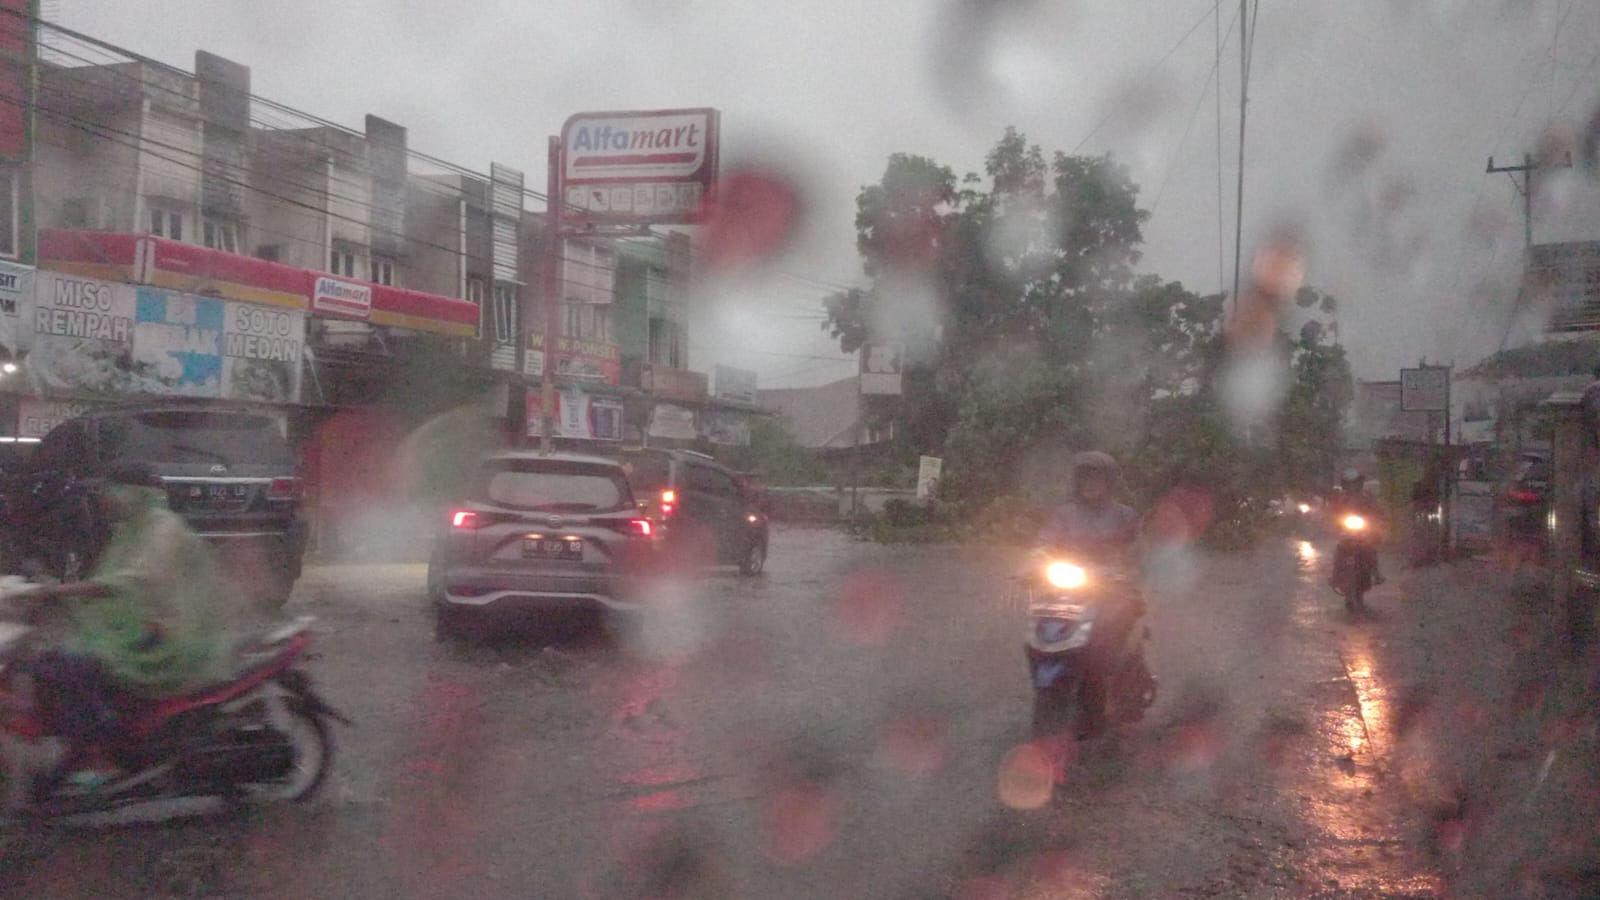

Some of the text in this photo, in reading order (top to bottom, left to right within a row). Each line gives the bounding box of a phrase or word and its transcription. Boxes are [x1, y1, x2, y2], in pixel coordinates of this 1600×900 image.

[573, 123, 699, 151] Alfamart
[54, 278, 112, 311] MISO
[319, 279, 369, 302] Alfamart
[35, 307, 132, 342] REMPAH
[235, 305, 291, 336] SOTO
[225, 332, 298, 362] MEDAN
